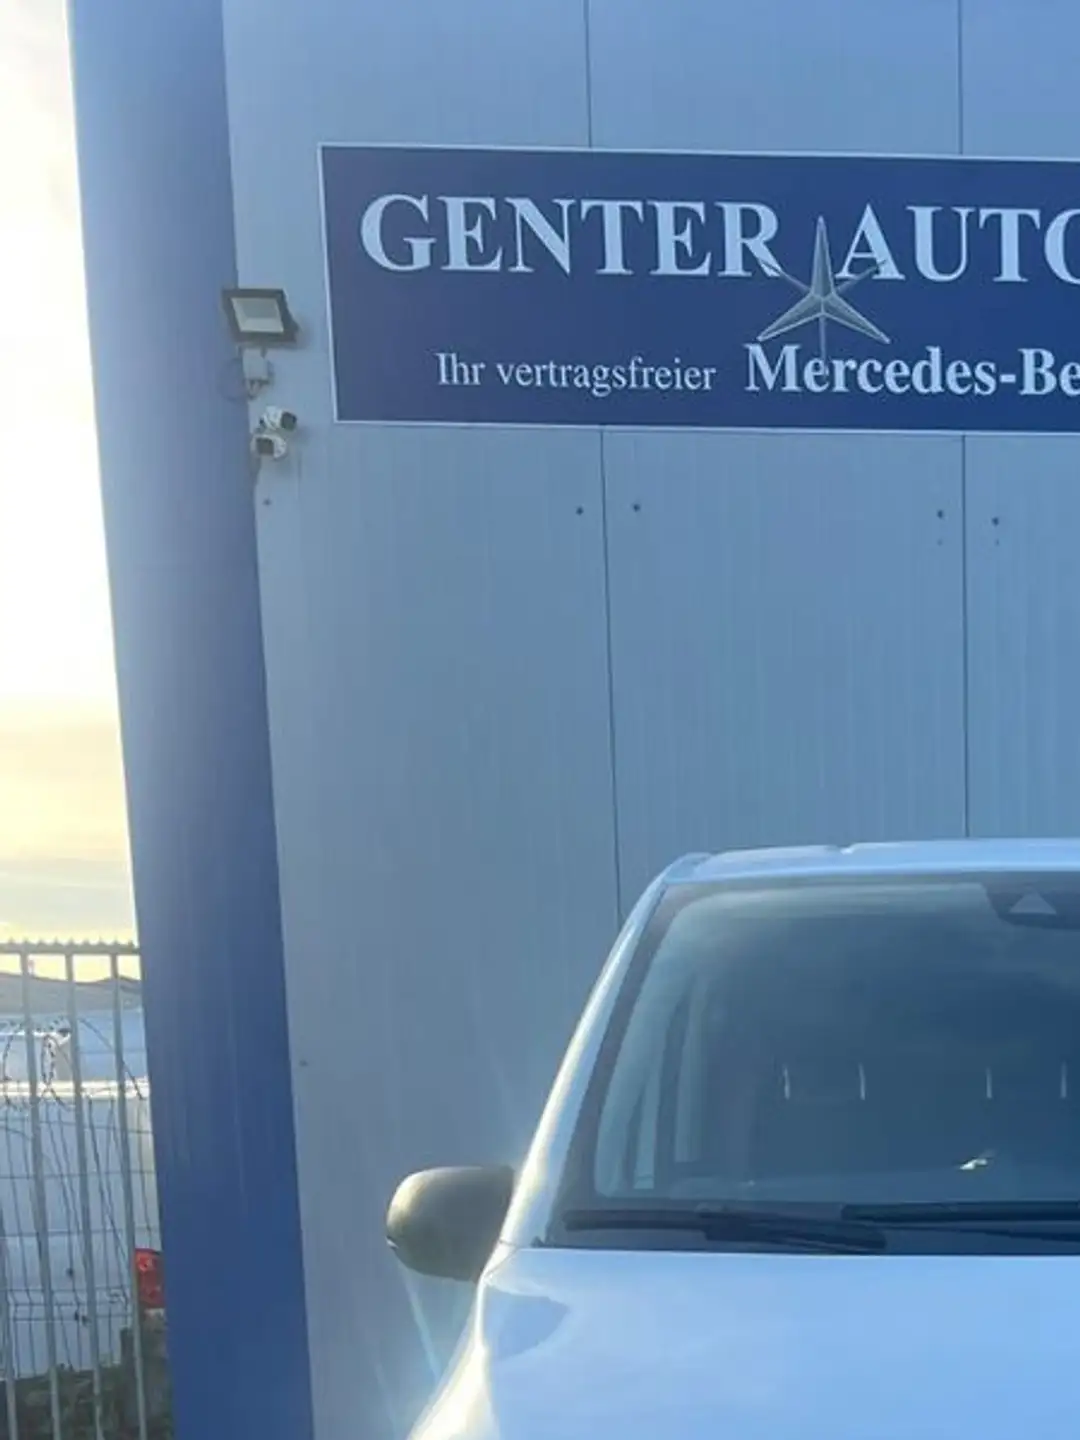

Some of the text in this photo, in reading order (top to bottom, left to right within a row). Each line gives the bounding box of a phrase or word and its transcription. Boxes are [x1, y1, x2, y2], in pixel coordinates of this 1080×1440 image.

[360, 194, 782, 278] GENTER
[435, 352, 486, 387] Ihr
[497, 355, 716, 397] vertragsfreier
